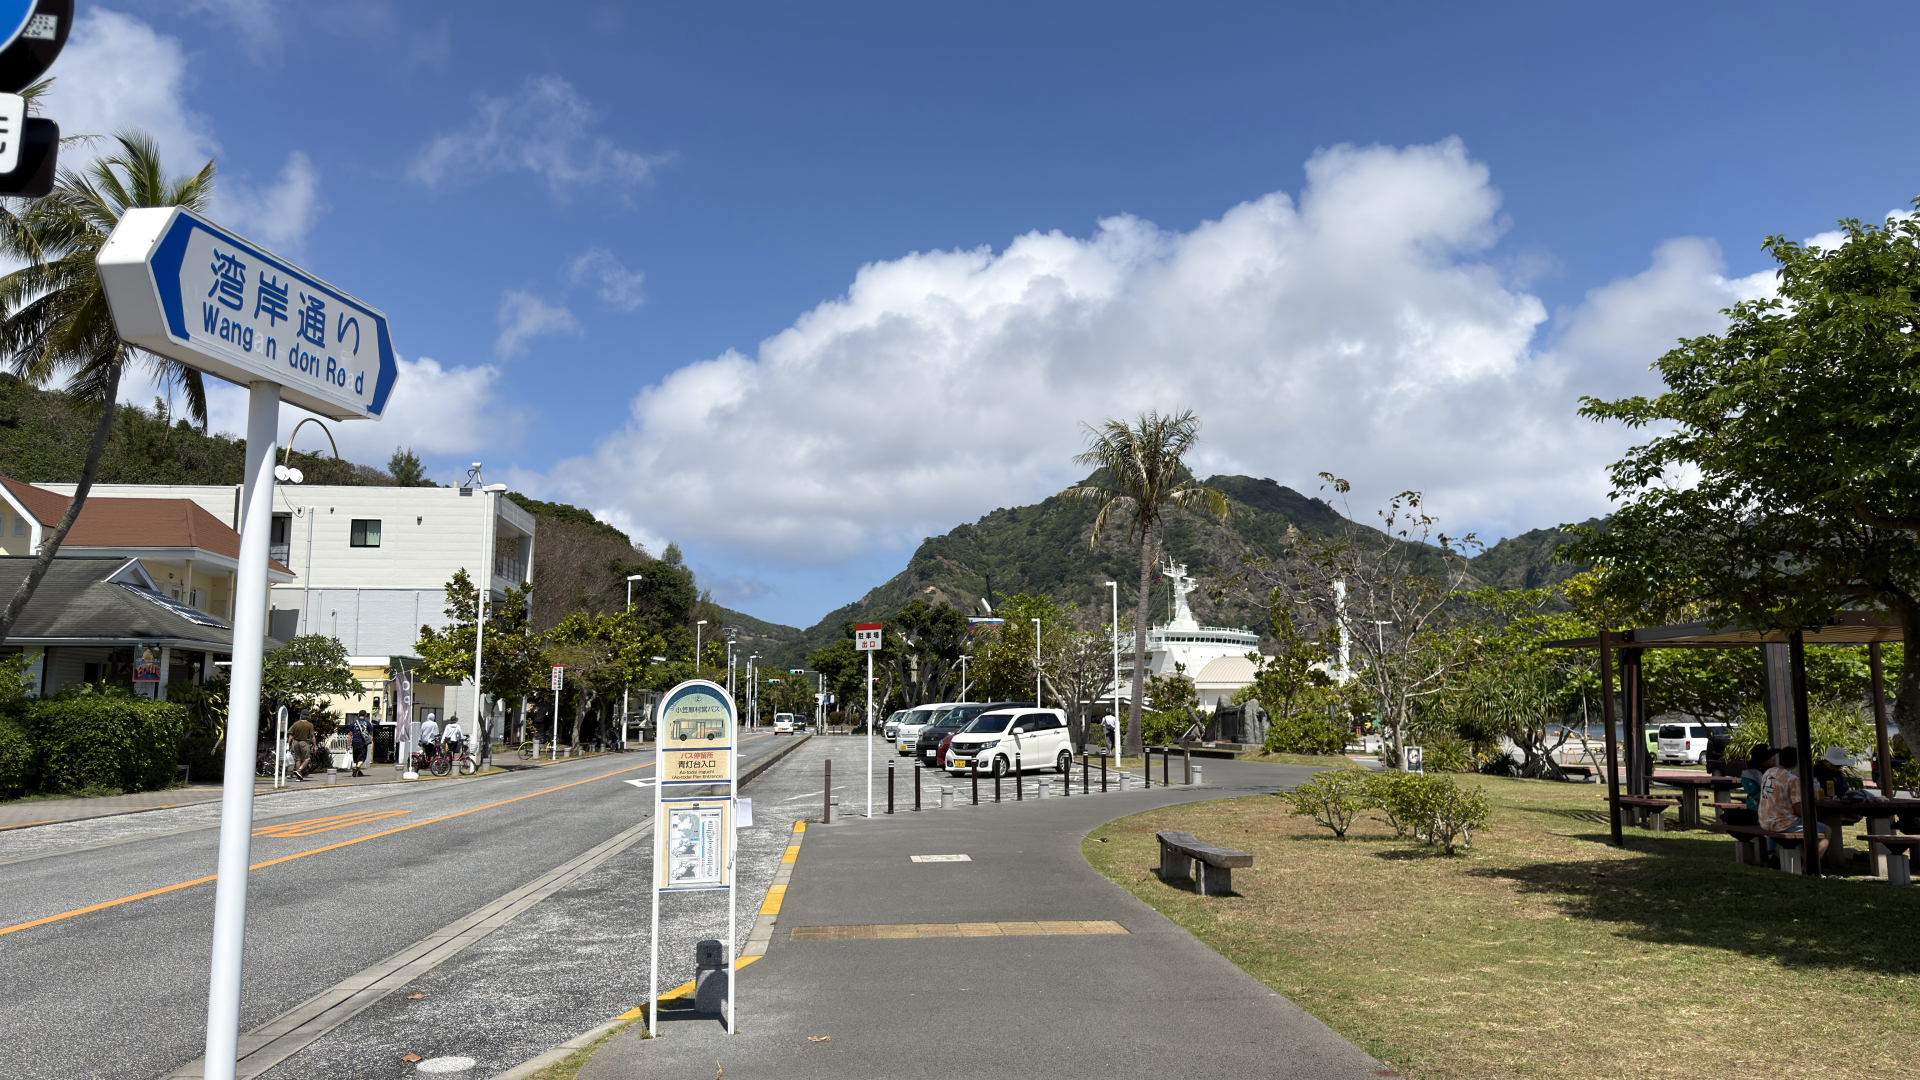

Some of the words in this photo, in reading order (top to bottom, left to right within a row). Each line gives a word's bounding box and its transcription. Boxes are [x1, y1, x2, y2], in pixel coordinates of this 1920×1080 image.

[207, 247, 360, 357] 湾岸通り
[675, 705, 721, 714] 小笠原村営バス
[678, 760, 716, 769] 青灯台入口
